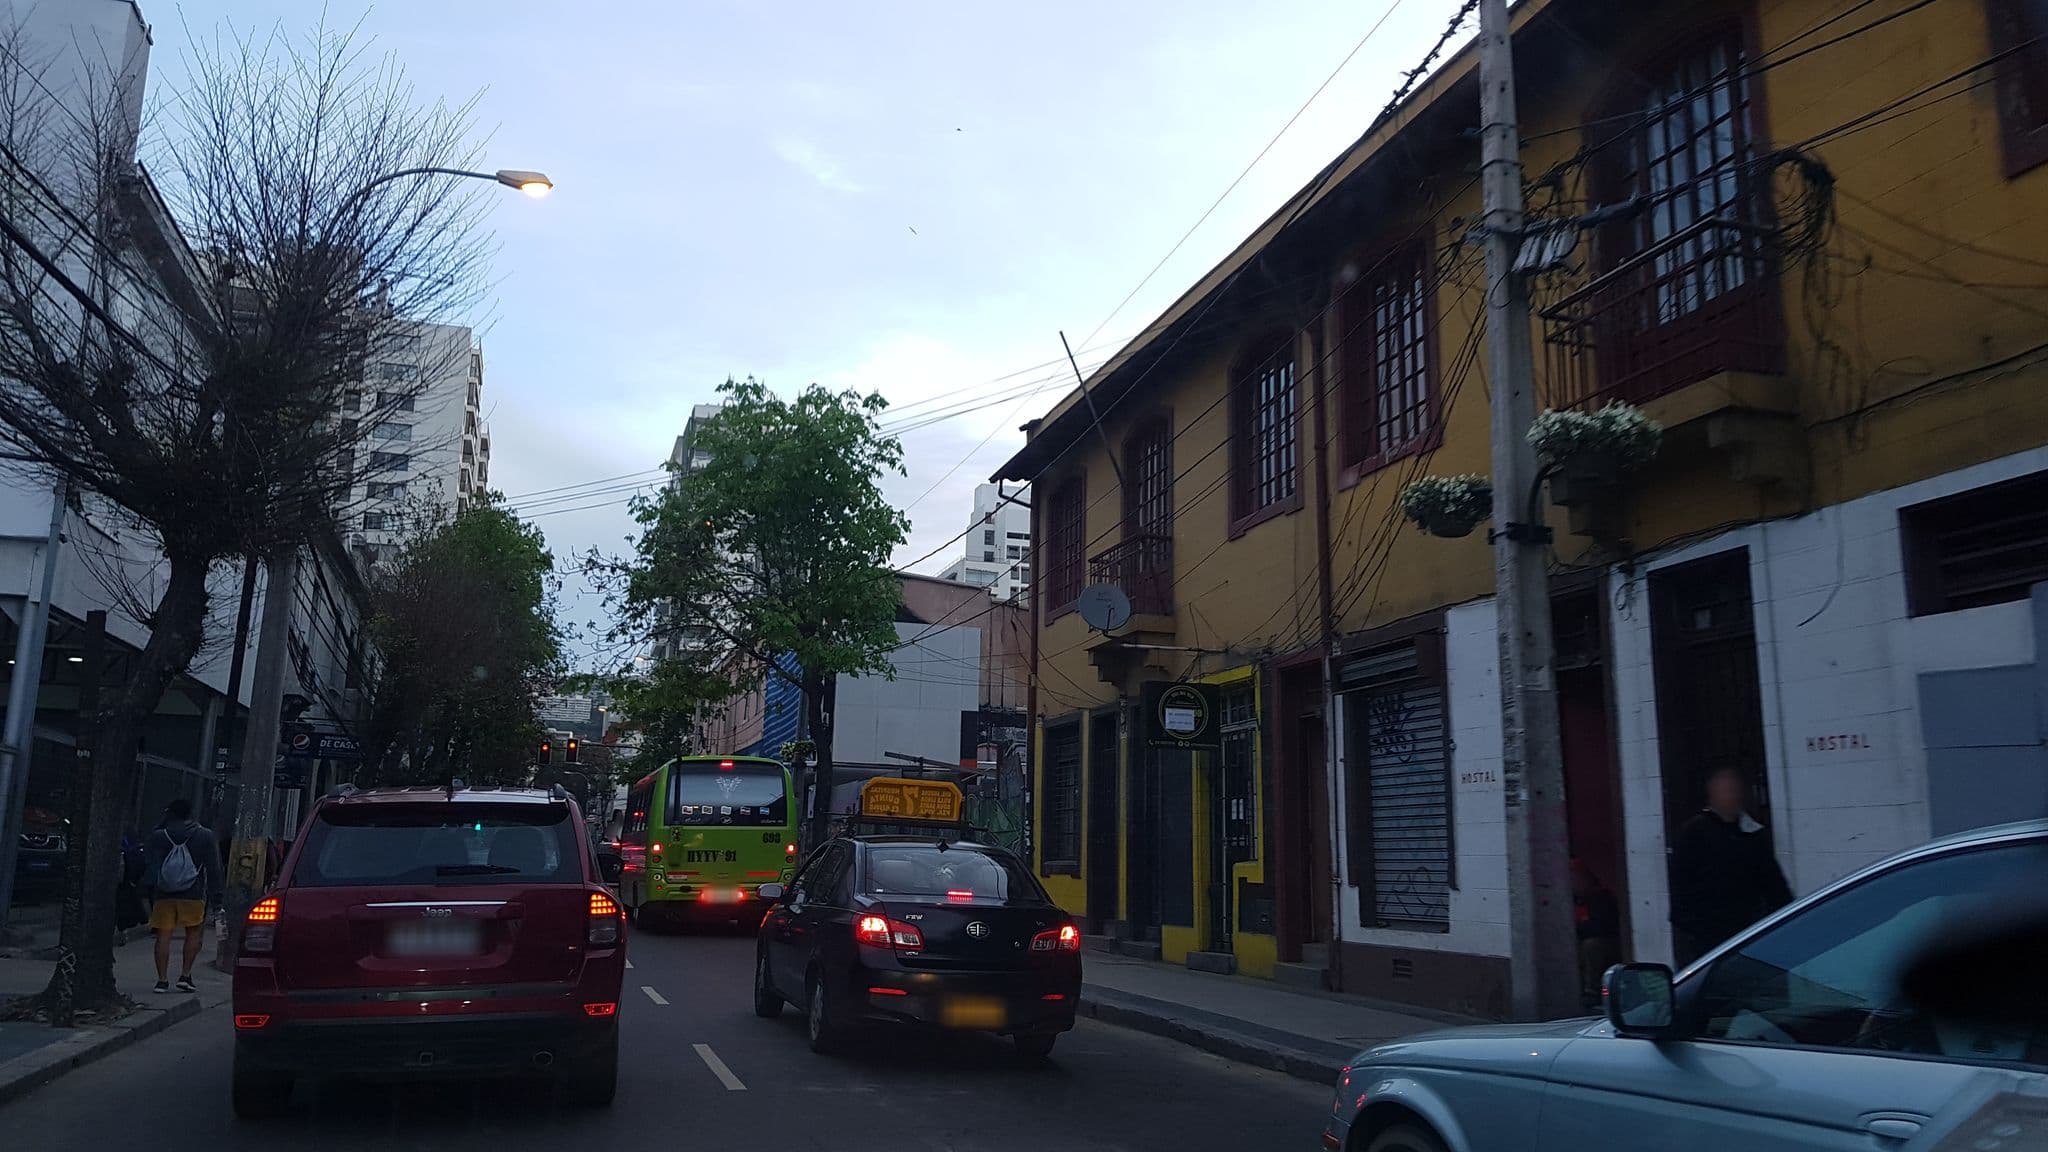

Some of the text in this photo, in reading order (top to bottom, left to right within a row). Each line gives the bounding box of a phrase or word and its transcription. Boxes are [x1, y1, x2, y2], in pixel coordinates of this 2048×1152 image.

[319, 739, 333, 748] DE
[1807, 733, 1871, 752] HOSTAL
[1461, 768, 1496, 784] HOSTAL
[421, 905, 452, 919] Jeep
